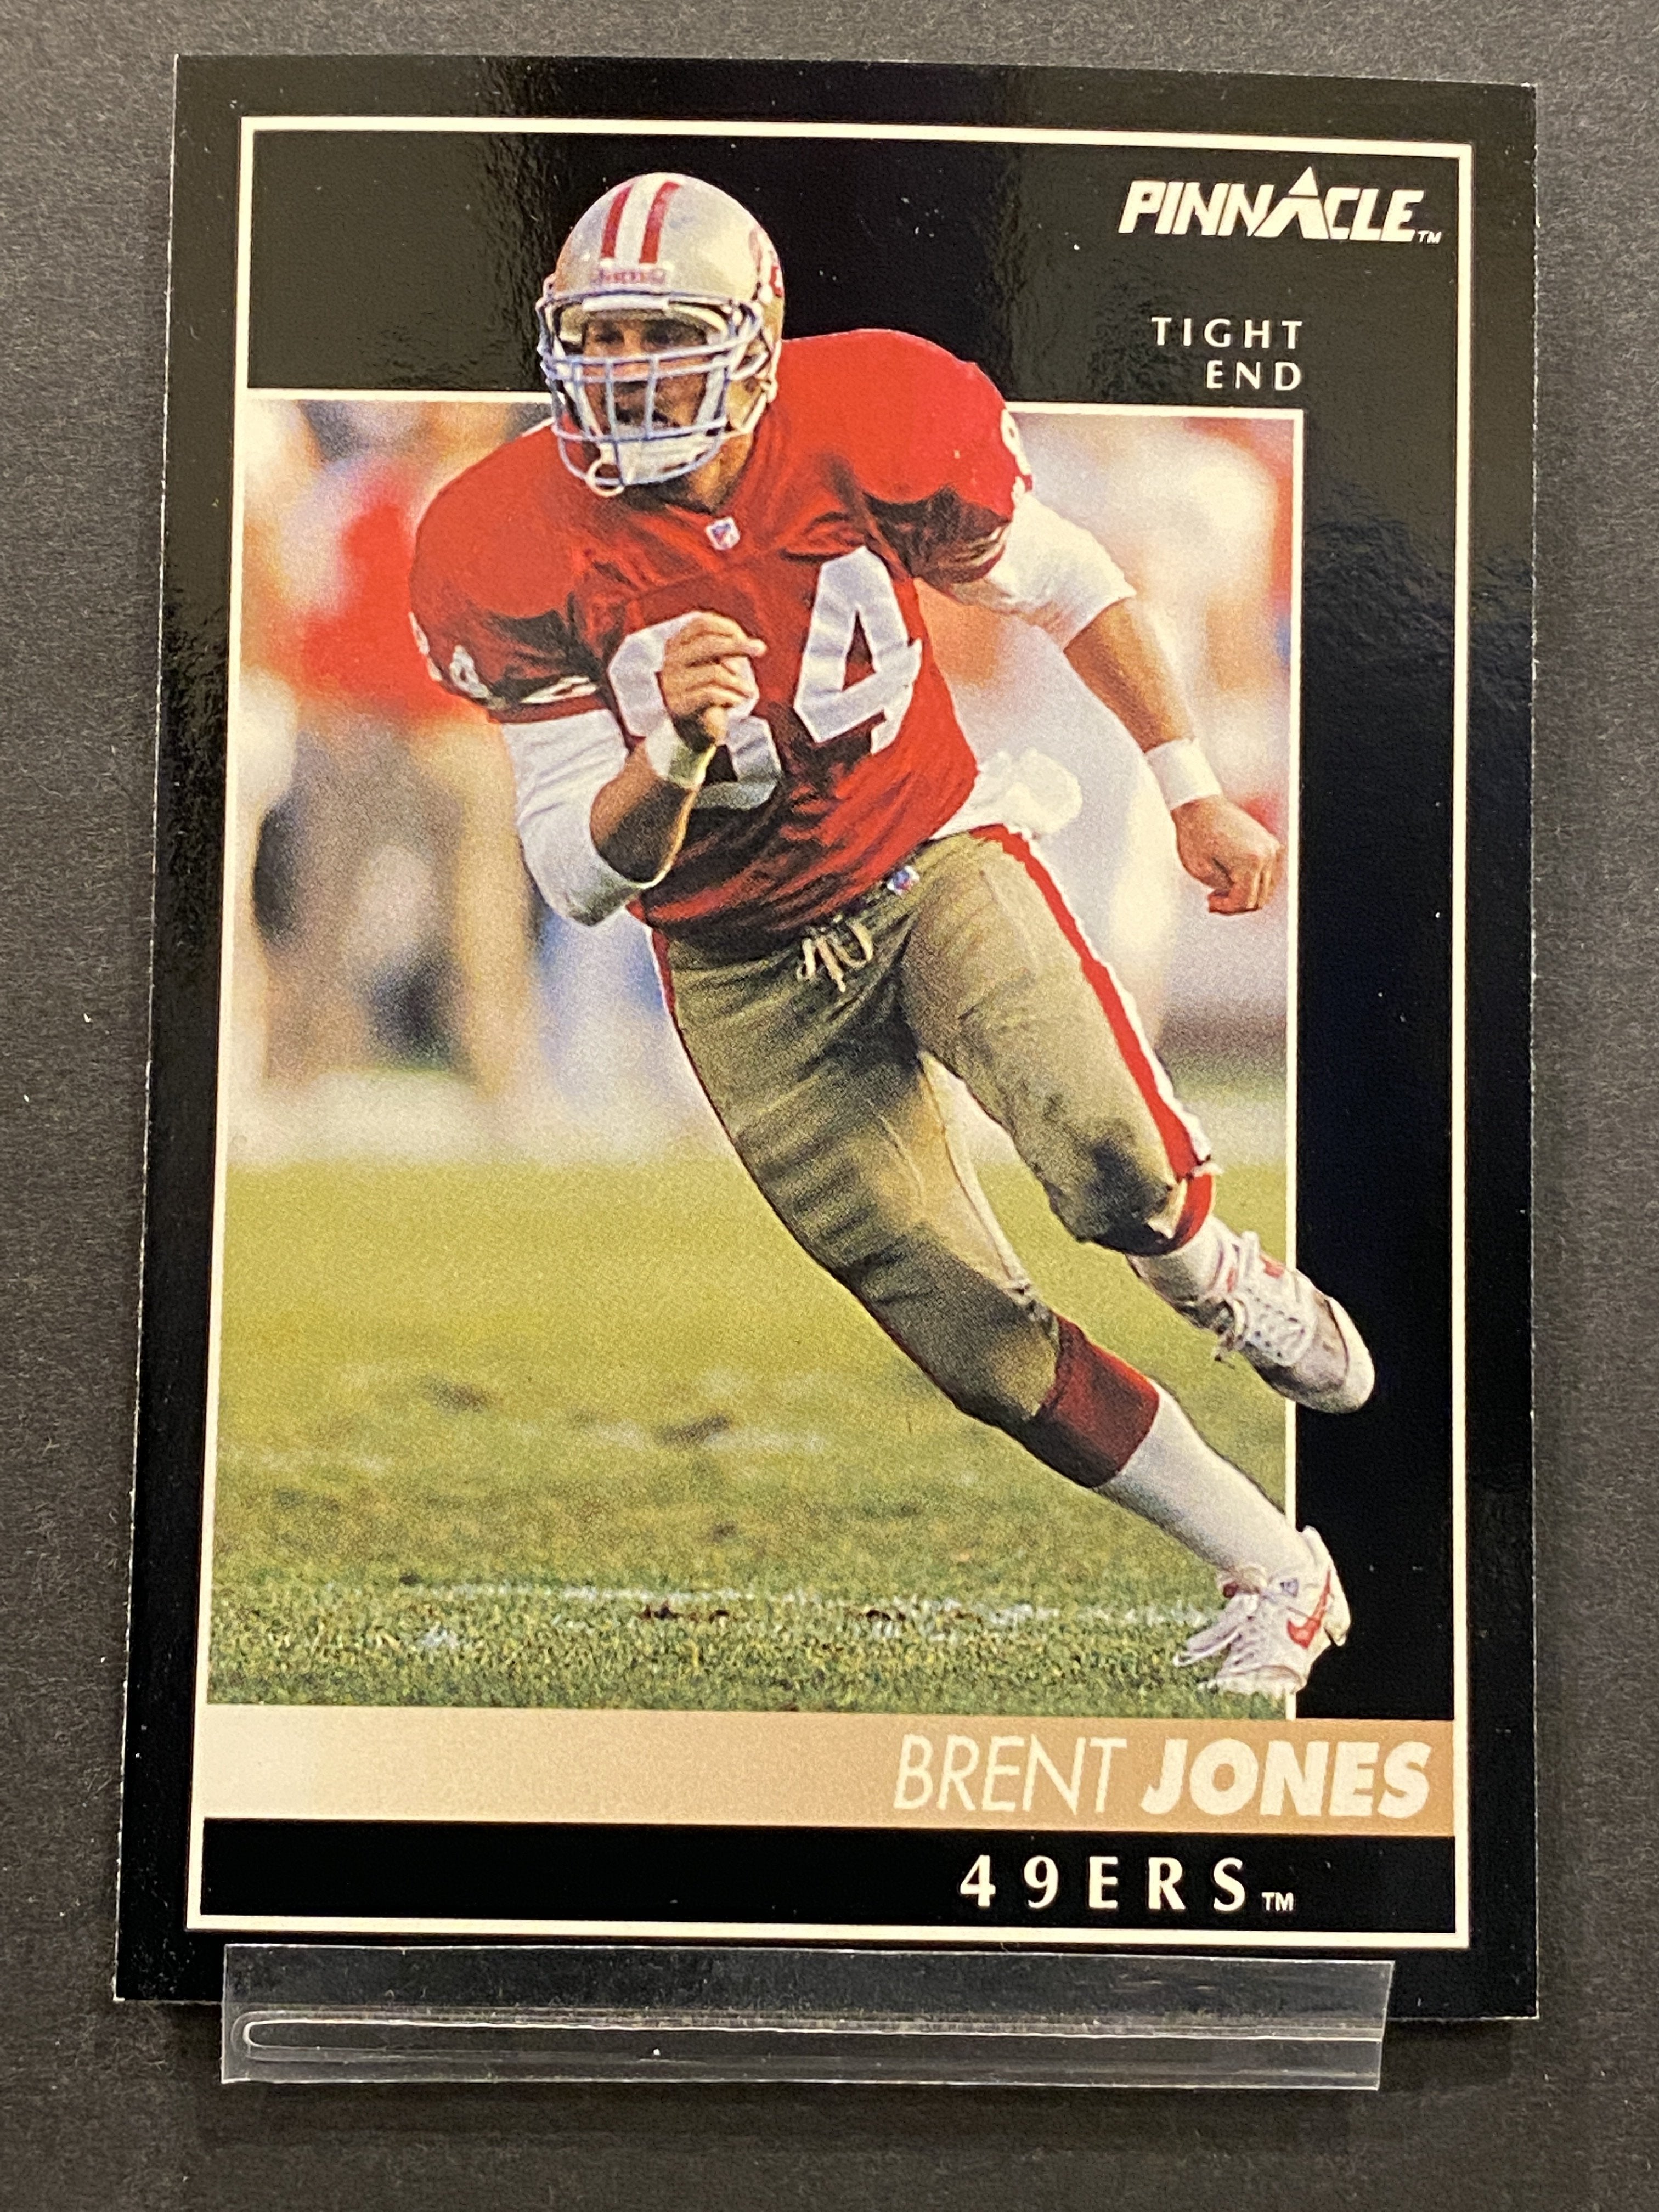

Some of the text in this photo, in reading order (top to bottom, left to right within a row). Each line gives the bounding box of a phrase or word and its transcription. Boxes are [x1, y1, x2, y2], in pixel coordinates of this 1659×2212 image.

[1119, 166, 1424, 242] PINNACLE
[1151, 317, 1303, 349] TIGHT
[1206, 360, 1302, 391] END
[893, 1733, 1432, 1819] BRENT JONES
[960, 1854, 1246, 1912] 49ERS
